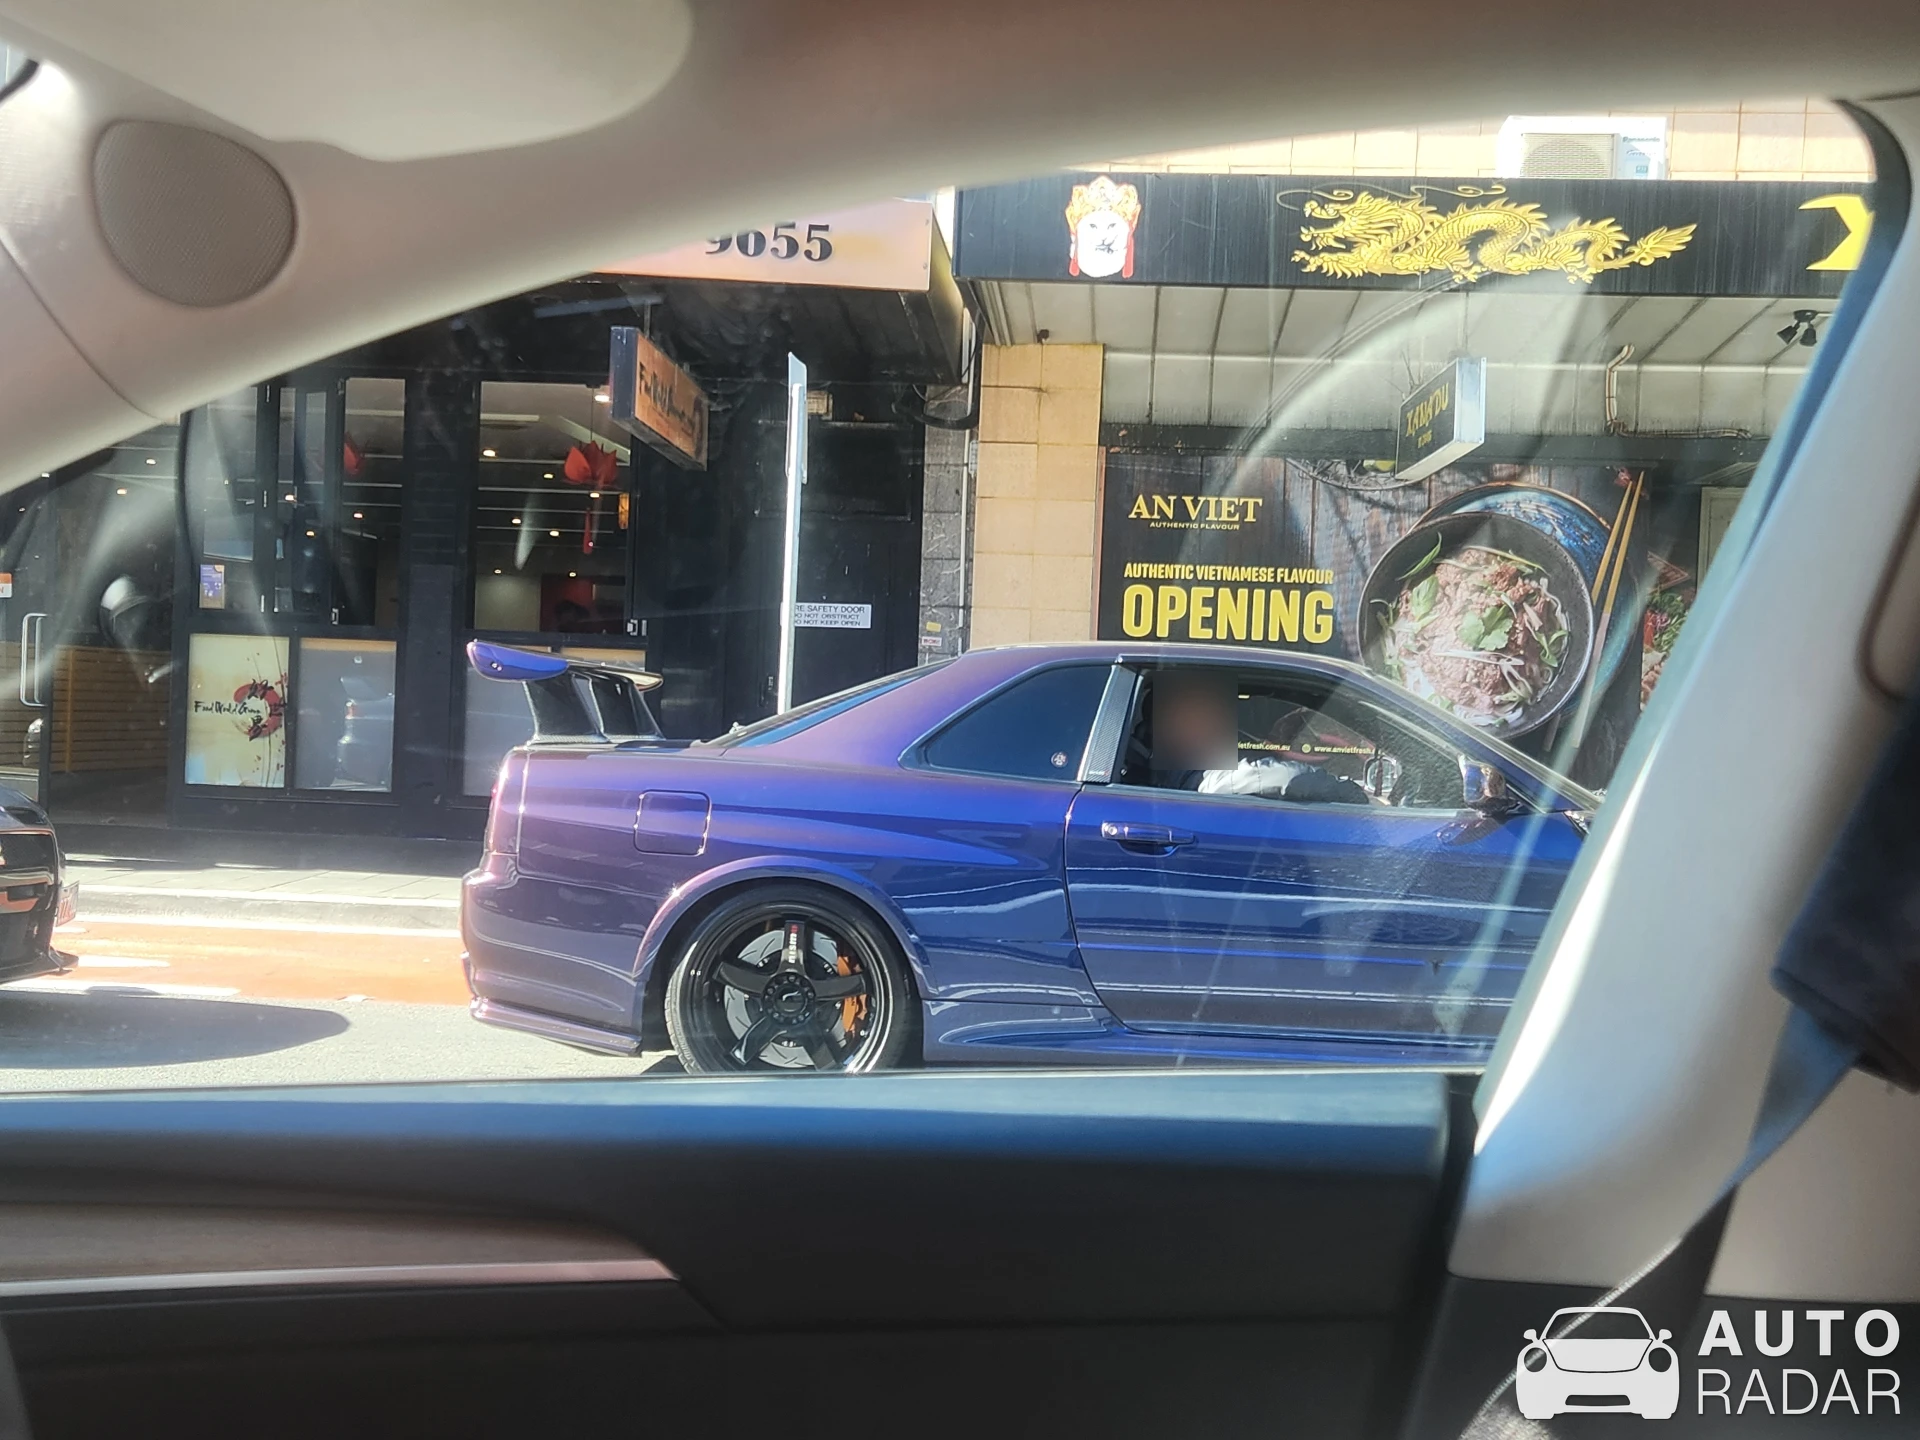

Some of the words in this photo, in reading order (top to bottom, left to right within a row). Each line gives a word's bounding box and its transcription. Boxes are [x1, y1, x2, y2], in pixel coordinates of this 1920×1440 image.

[1128, 494, 1177, 520] AN
[1182, 495, 1263, 522] VIET
[1149, 521, 1198, 529] AUTHENTIC
[1124, 562, 1194, 580] AUTHENTIC
[1196, 564, 1275, 583] VIETNAMESE
[1276, 567, 1334, 585] FLAVOUR
[807, 604, 839, 613] SAFETY
[841, 605, 865, 613] DOOR
[1122, 583, 1334, 644] OPENING
